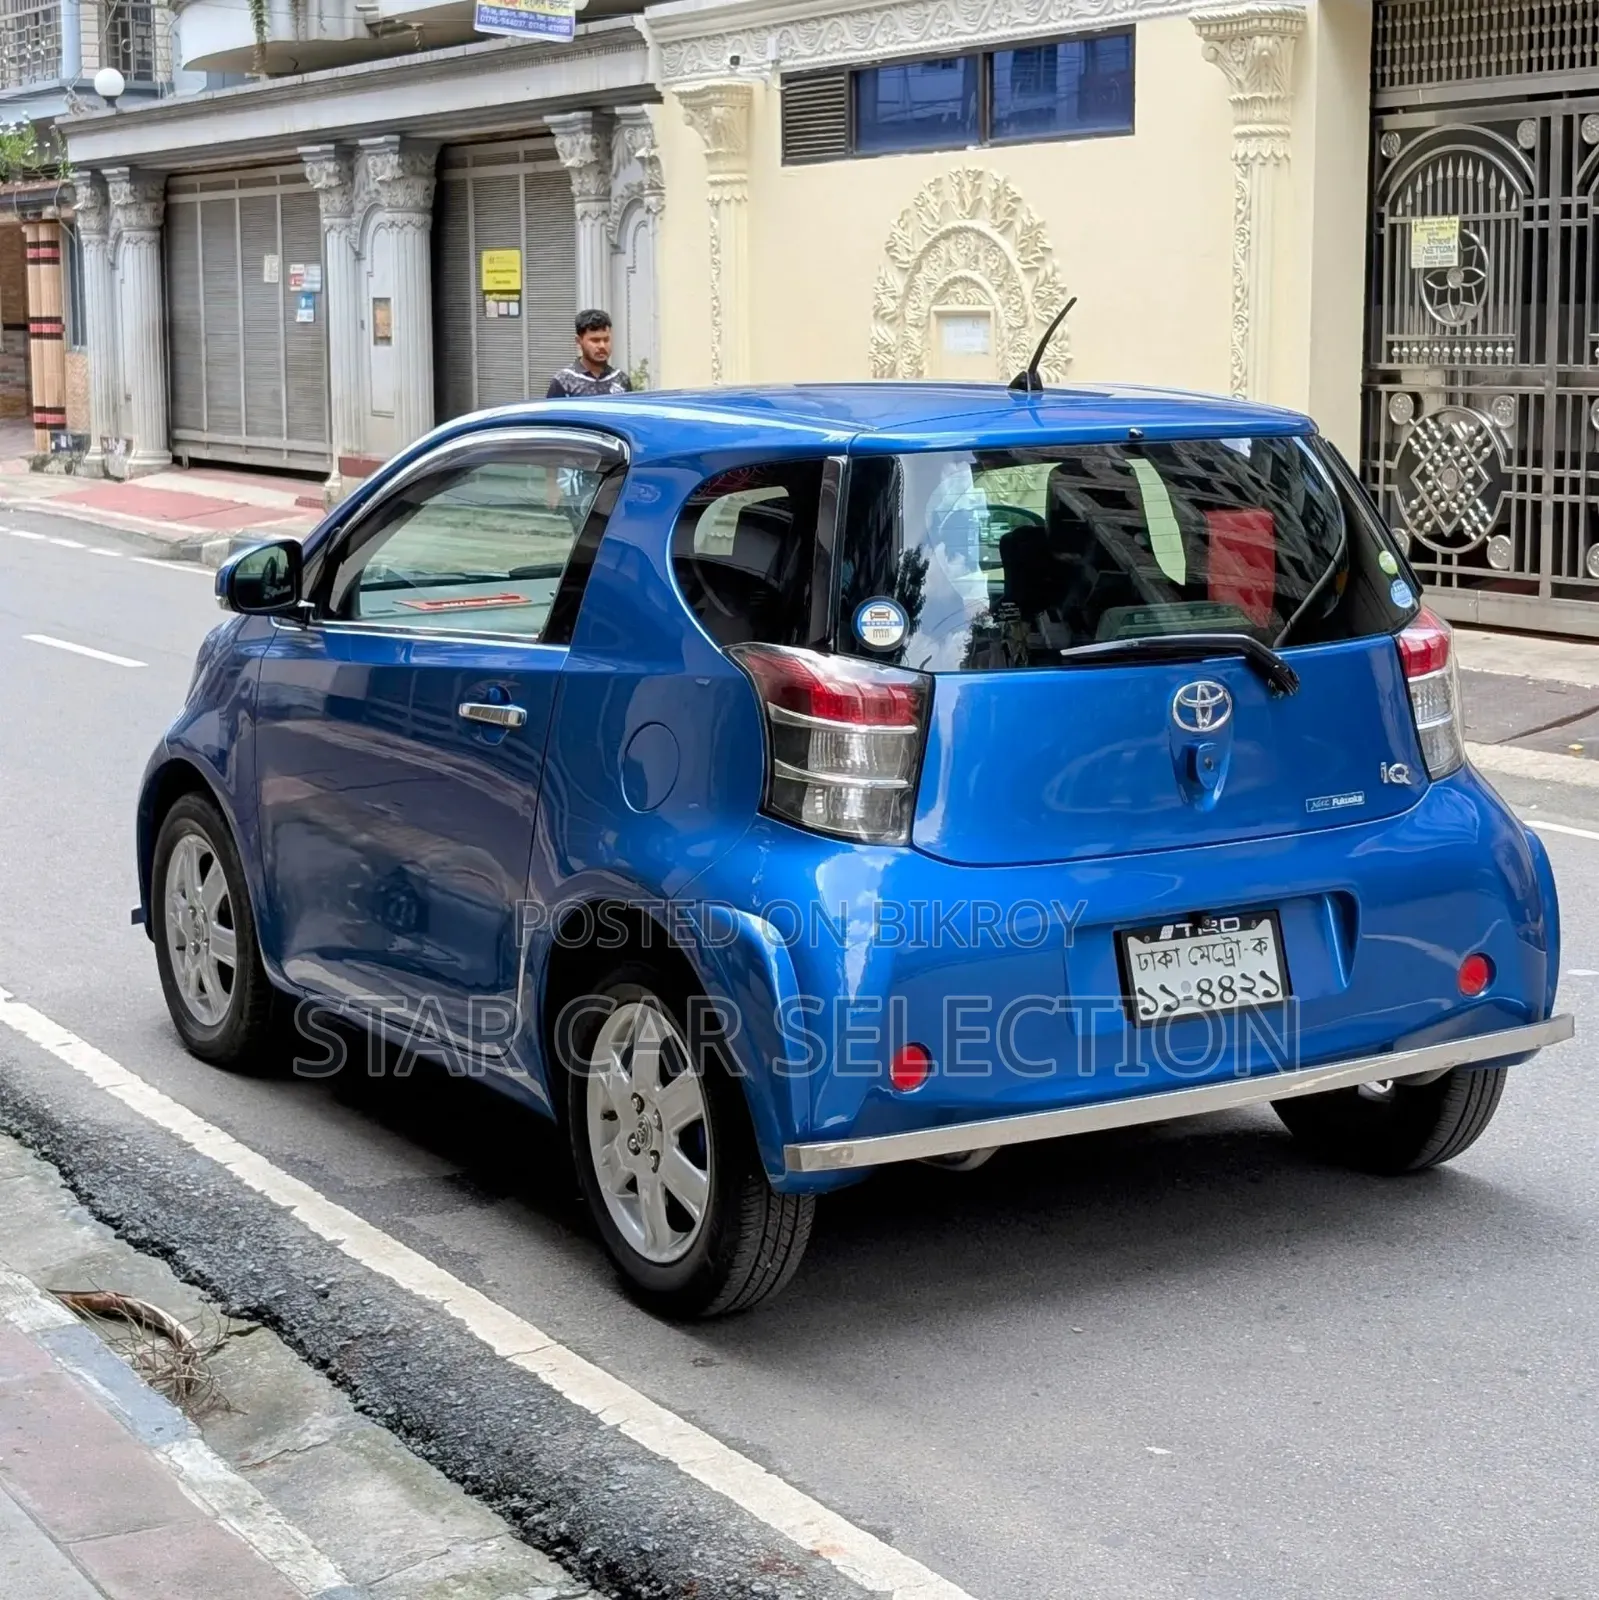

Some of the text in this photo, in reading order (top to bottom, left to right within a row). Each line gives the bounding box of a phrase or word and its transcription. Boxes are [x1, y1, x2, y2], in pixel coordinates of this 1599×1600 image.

[1380, 762, 1412, 785] iQ
[1136, 947, 1181, 972] ঢাকা
[1137, 970, 1280, 1016] ১১-৪৪২১
